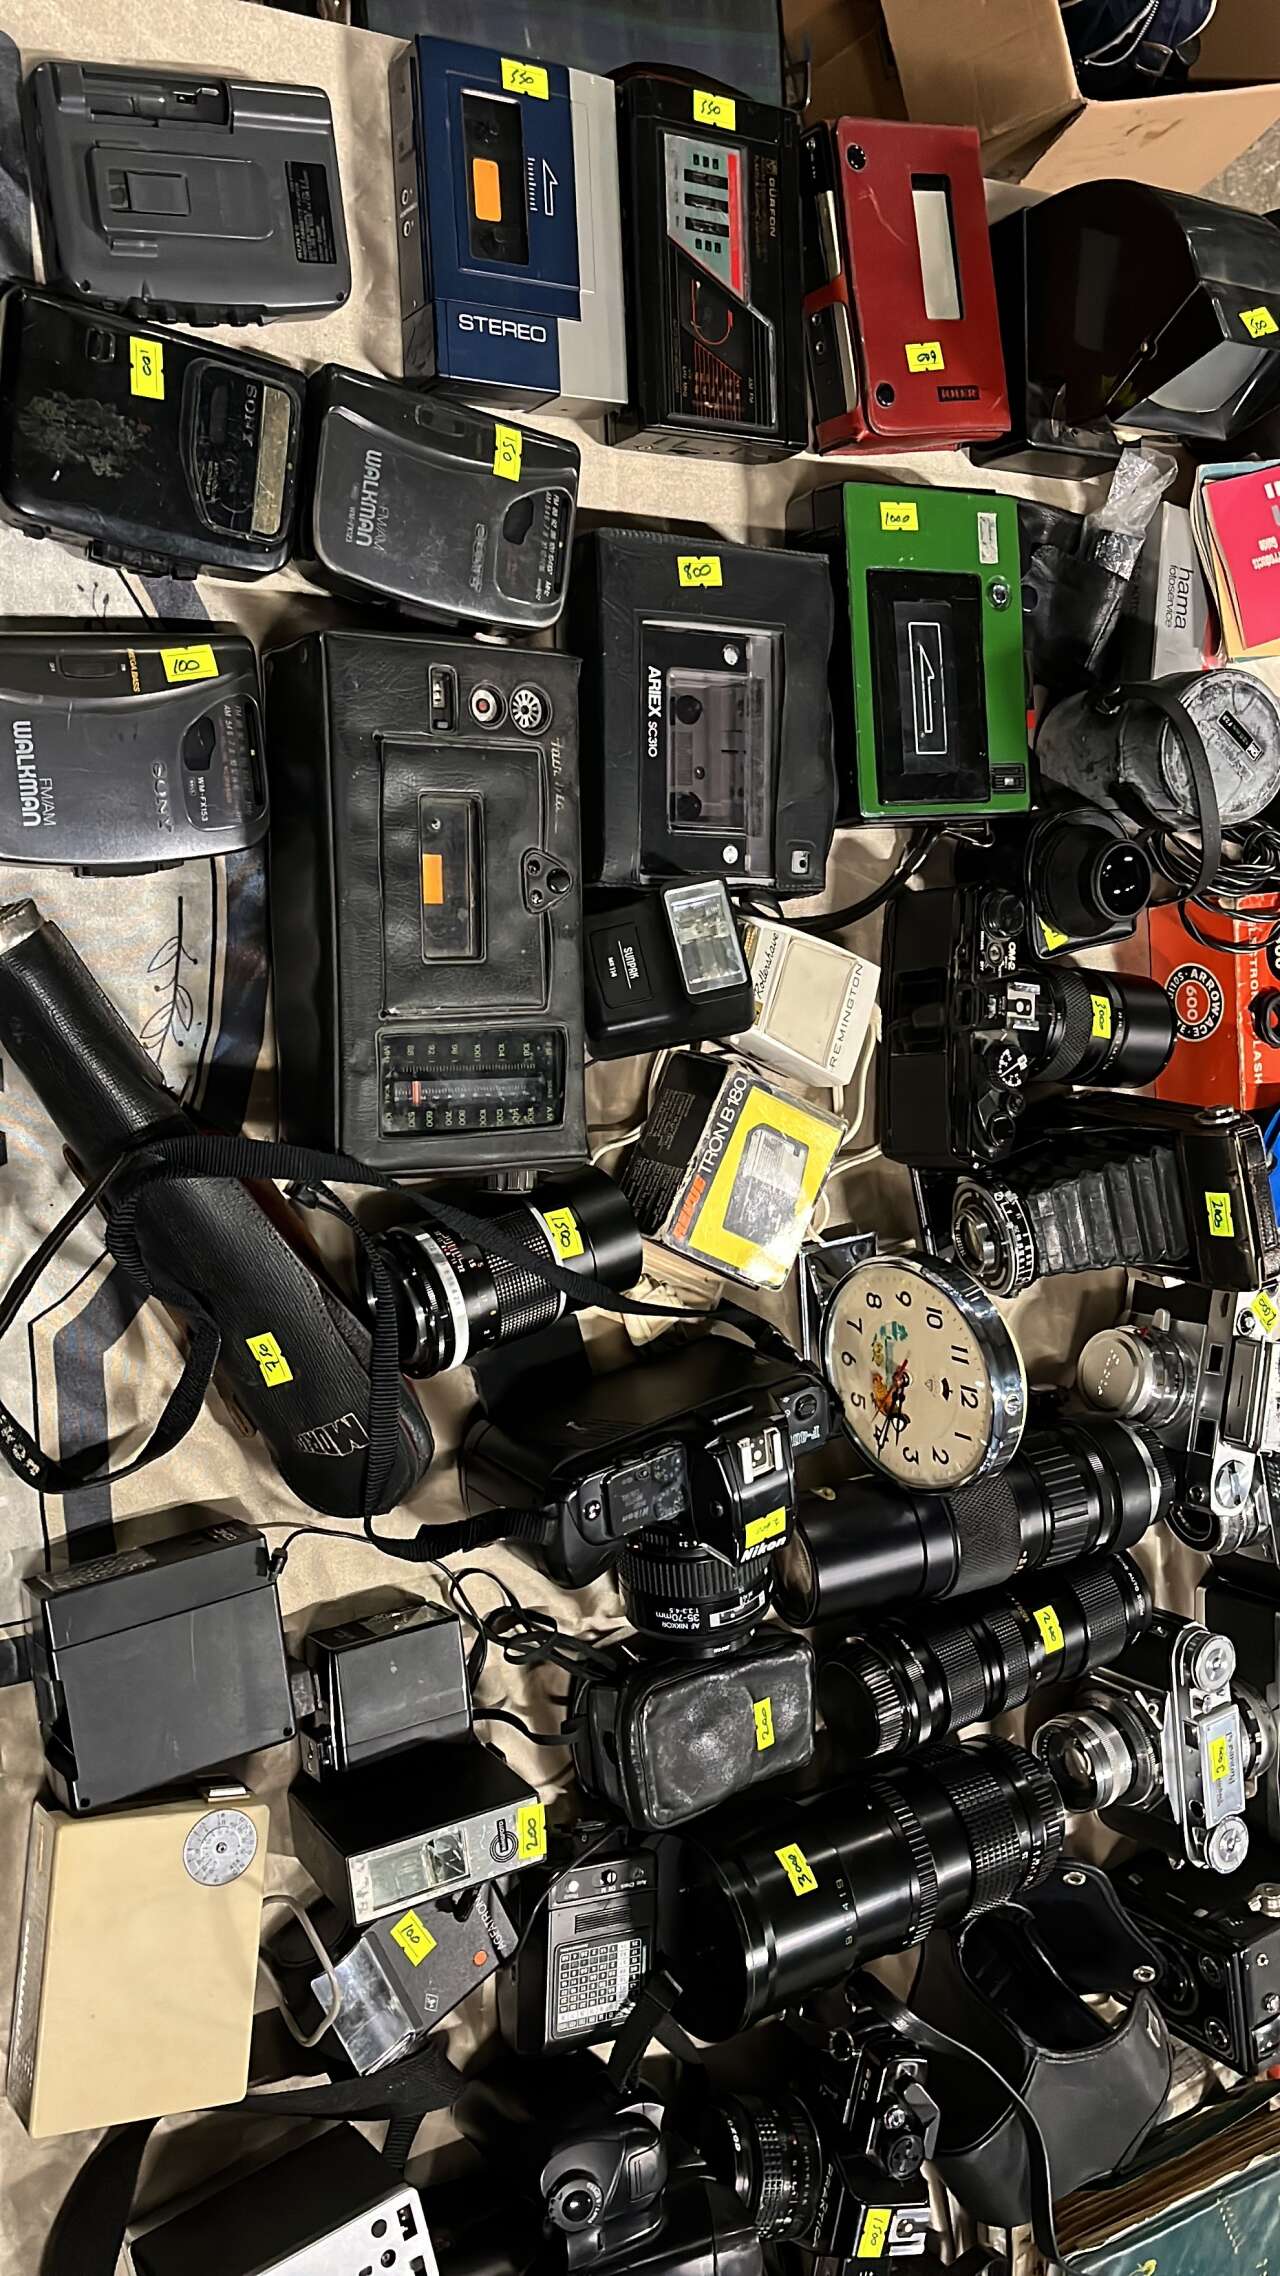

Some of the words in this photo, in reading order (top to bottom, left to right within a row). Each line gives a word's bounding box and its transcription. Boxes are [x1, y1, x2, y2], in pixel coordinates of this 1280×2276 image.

[510, 68, 535, 85] 550
[700, 100, 721, 115] 550
[457, 313, 547, 343] STEREO
[139, 349, 152, 377] 100
[242, 384, 258, 448] SONY
[502, 437, 517, 462] 150
[355, 449, 383, 547] WALKMAN
[371, 505, 391, 554] FM/AM
[885, 511, 911, 526] 1000
[683, 562, 712, 581] 800
[1165, 564, 1177, 628] fotoservice
[1174, 567, 1195, 629] hama
[172, 658, 200, 673] 100
[131, 673, 141, 693] BASS
[647, 665, 662, 718] ARIEX
[223, 704, 232, 717] AM
[647, 721, 658, 758] SC310
[12, 720, 42, 828] WALKMAN
[38, 777, 57, 826] FM/AM
[151, 760, 175, 833] SONY
[197, 776, 209, 822] WM-FX153
[623, 945, 638, 980] SUNPAK
[1007, 941, 1017, 971] OM-2
[1185, 985, 1198, 1021] 600
[829, 963, 864, 1068] REMINGTON
[425, 1110, 433, 1128] 600
[551, 1216, 571, 1249] 1500
[866, 1292, 882, 1310] 8
[896, 1291, 912, 1308] 9
[846, 1318, 863, 1335] 7
[926, 1306, 944, 1330] 10
[258, 1343, 281, 1374] 750
[841, 1351, 857, 1367] 6
[951, 1344, 970, 1366] 11
[850, 1392, 867, 1411] 5
[960, 1385, 979, 1409] 12
[954, 1431, 972, 1442] 1
[902, 1446, 919, 1465] 3
[932, 1446, 950, 1465] 2
[740, 1536, 787, 1563] Nikon
[1128, 1571, 1140, 1593] AUTO
[655, 1610, 700, 1622] 35-70mm
[661, 1620, 689, 1630] NIKKOR
[525, 1817, 539, 1850] 200
[400, 1923, 421, 1945] 100
